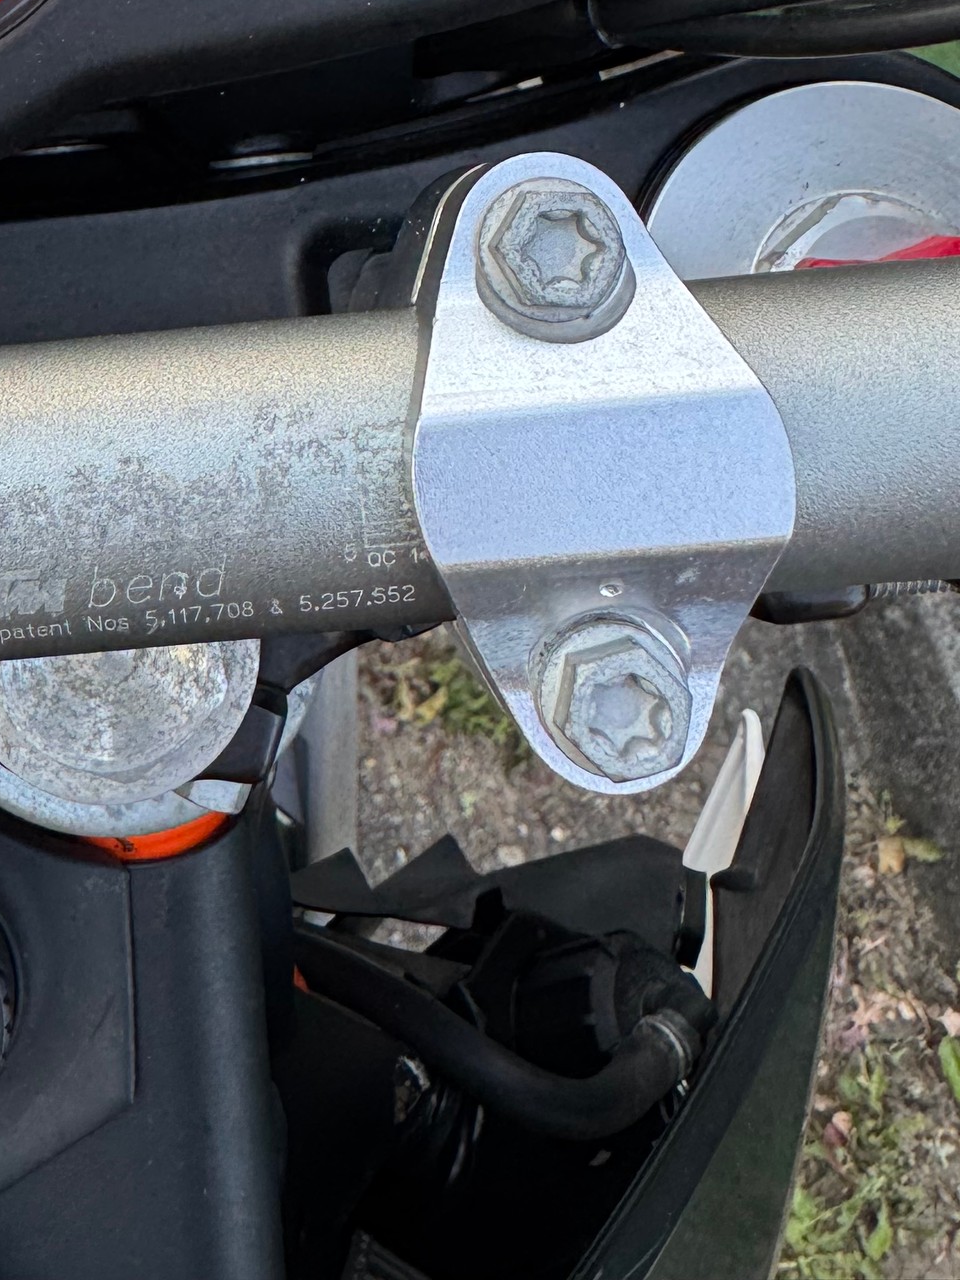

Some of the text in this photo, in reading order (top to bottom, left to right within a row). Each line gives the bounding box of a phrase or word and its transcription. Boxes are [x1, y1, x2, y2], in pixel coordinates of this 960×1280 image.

[88, 555, 227, 608] bend
[0, 619, 73, 644] patent
[86, 614, 130, 634] Nos
